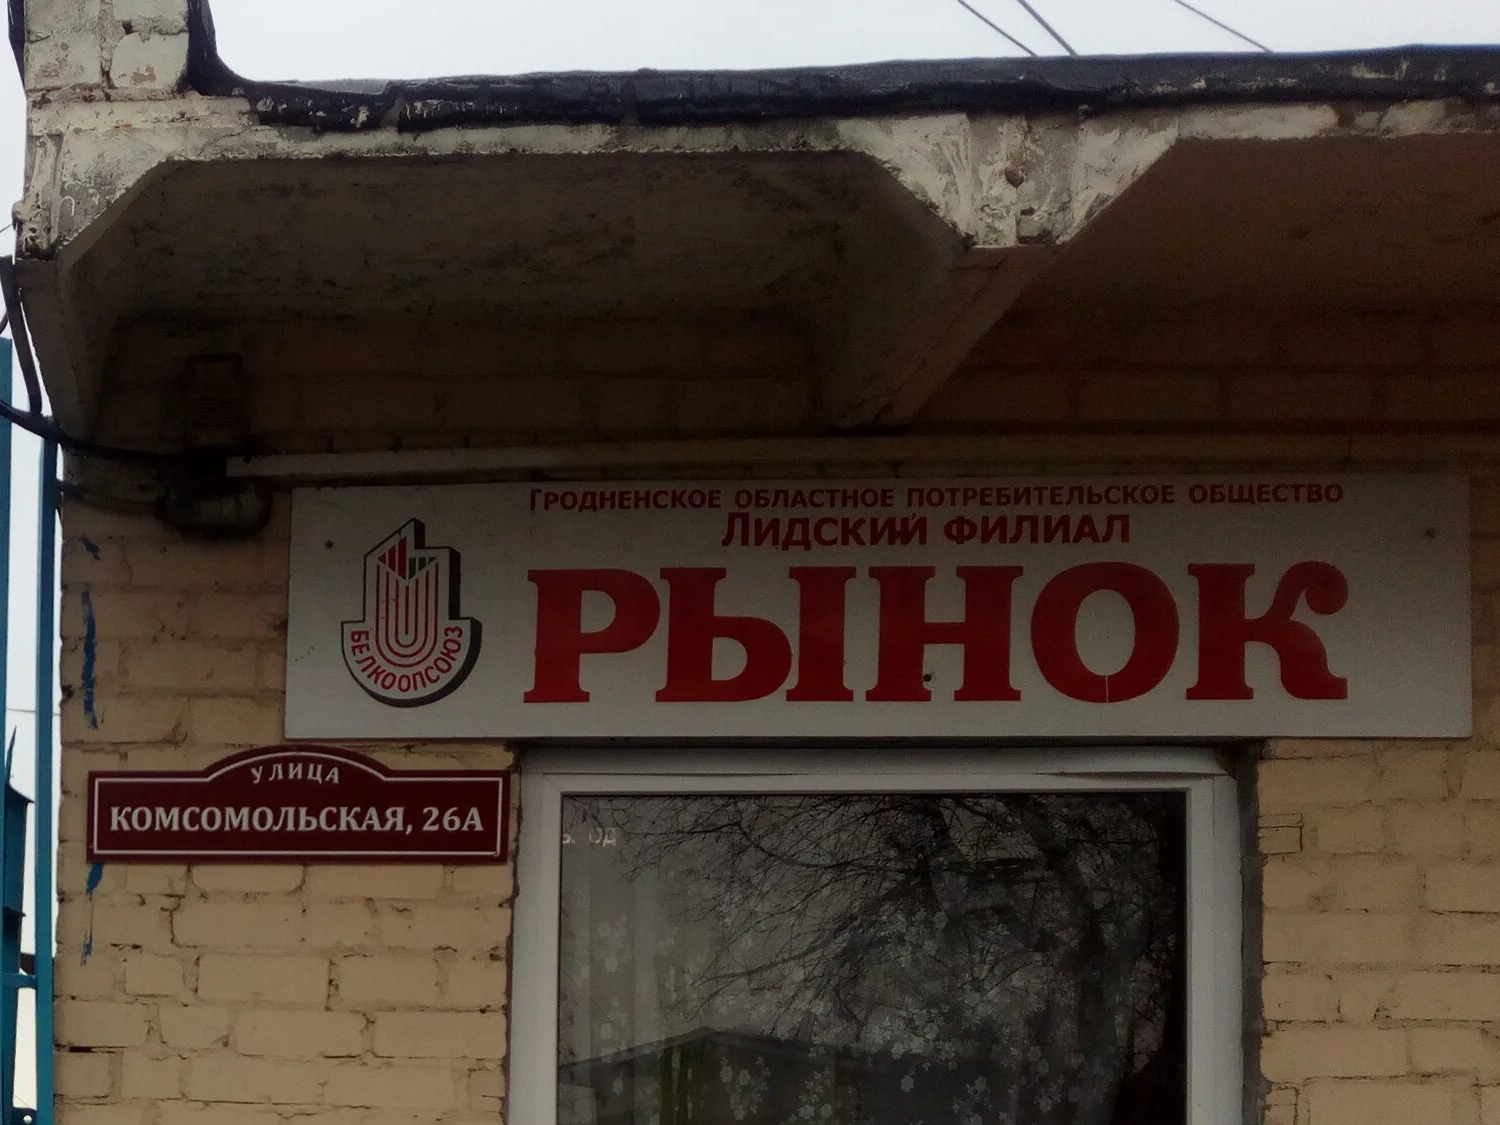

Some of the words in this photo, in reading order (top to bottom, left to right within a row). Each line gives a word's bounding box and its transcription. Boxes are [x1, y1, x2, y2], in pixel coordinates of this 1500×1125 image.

[523, 560, 1350, 704] РЫНОК
[349, 625, 464, 694] БЕЛКООПСОЮЗ
[251, 763, 341, 786] УЛИЦА
[110, 806, 413, 836] КОМСОМОЛЬСКАЯ,
[422, 806, 485, 833] 26А
